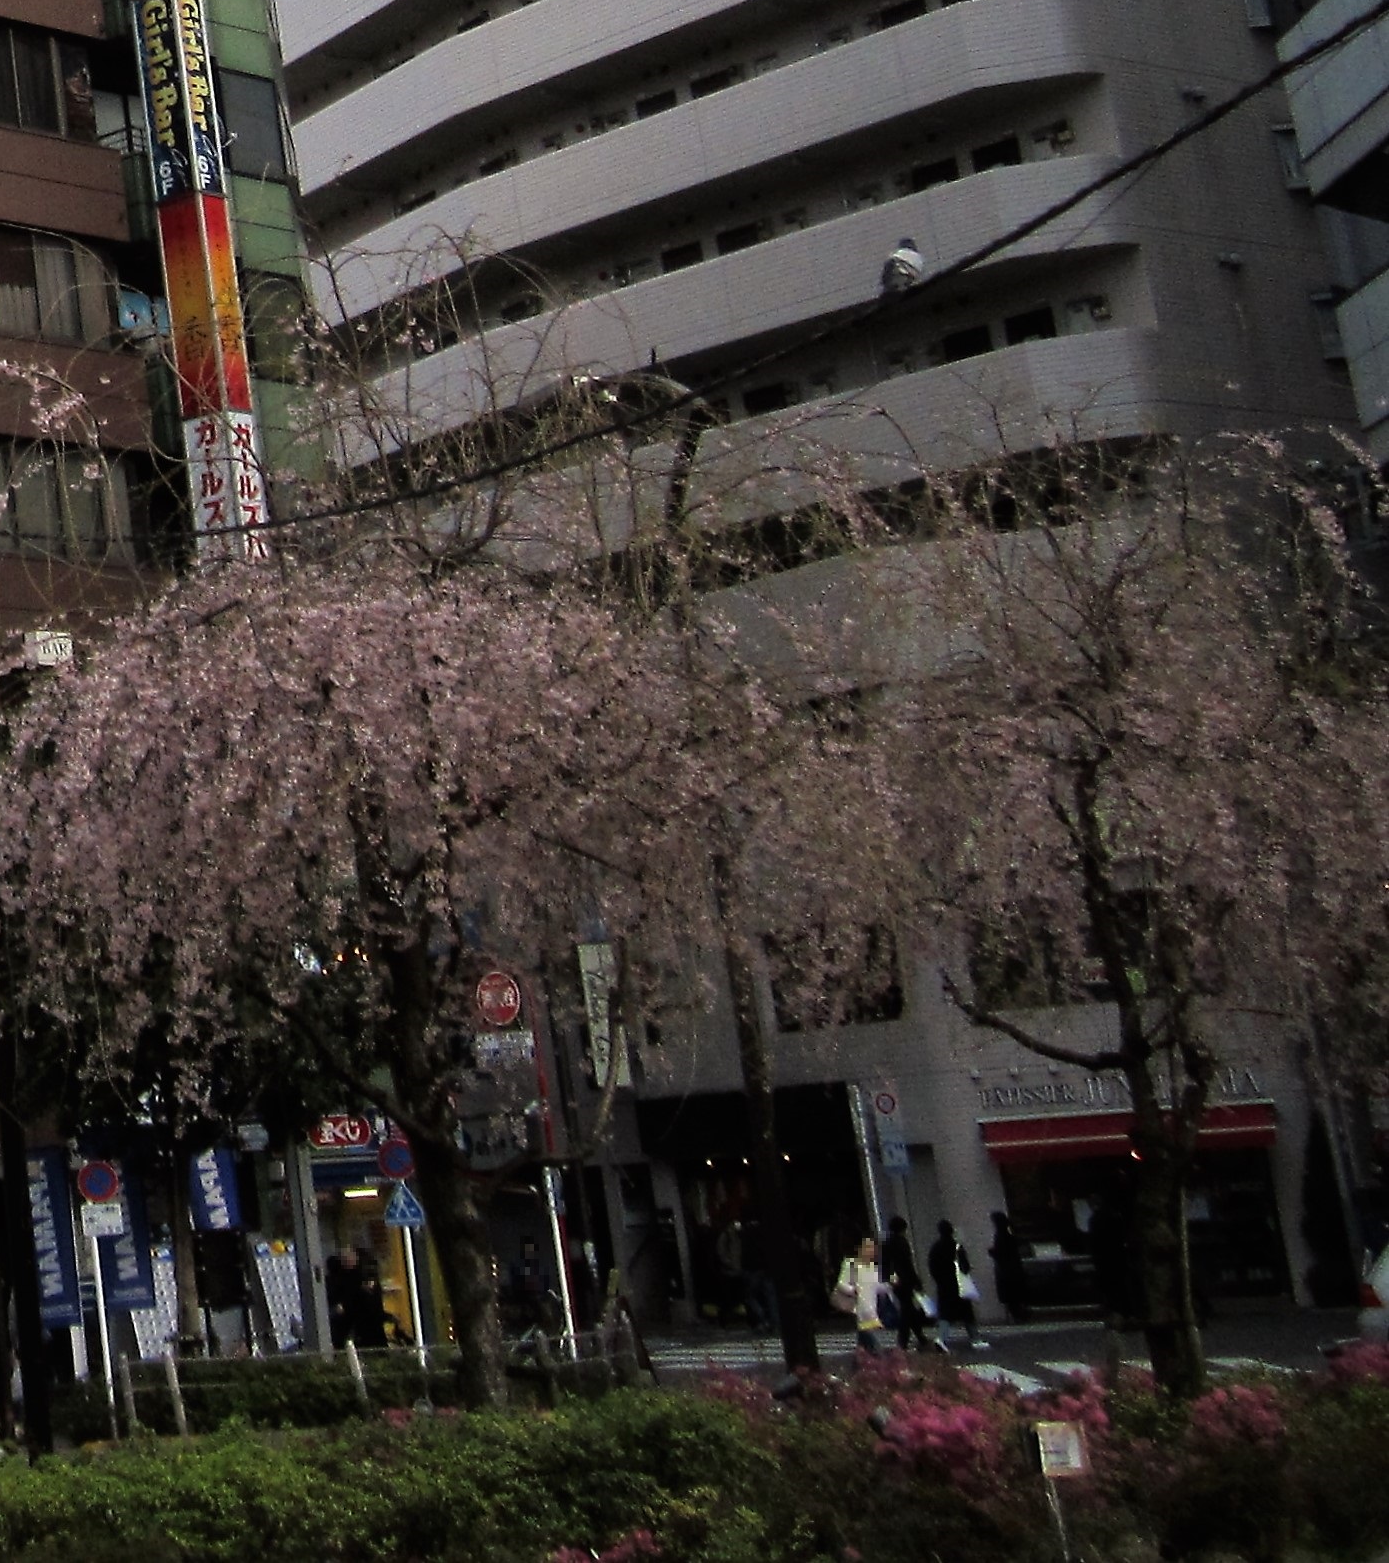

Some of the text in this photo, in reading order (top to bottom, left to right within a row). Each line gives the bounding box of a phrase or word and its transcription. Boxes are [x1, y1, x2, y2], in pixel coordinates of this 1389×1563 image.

[152, 82, 178, 148] Bar
[188, 71, 210, 132] Bar
[158, 161, 173, 195] 6F
[197, 155, 212, 189] 6F
